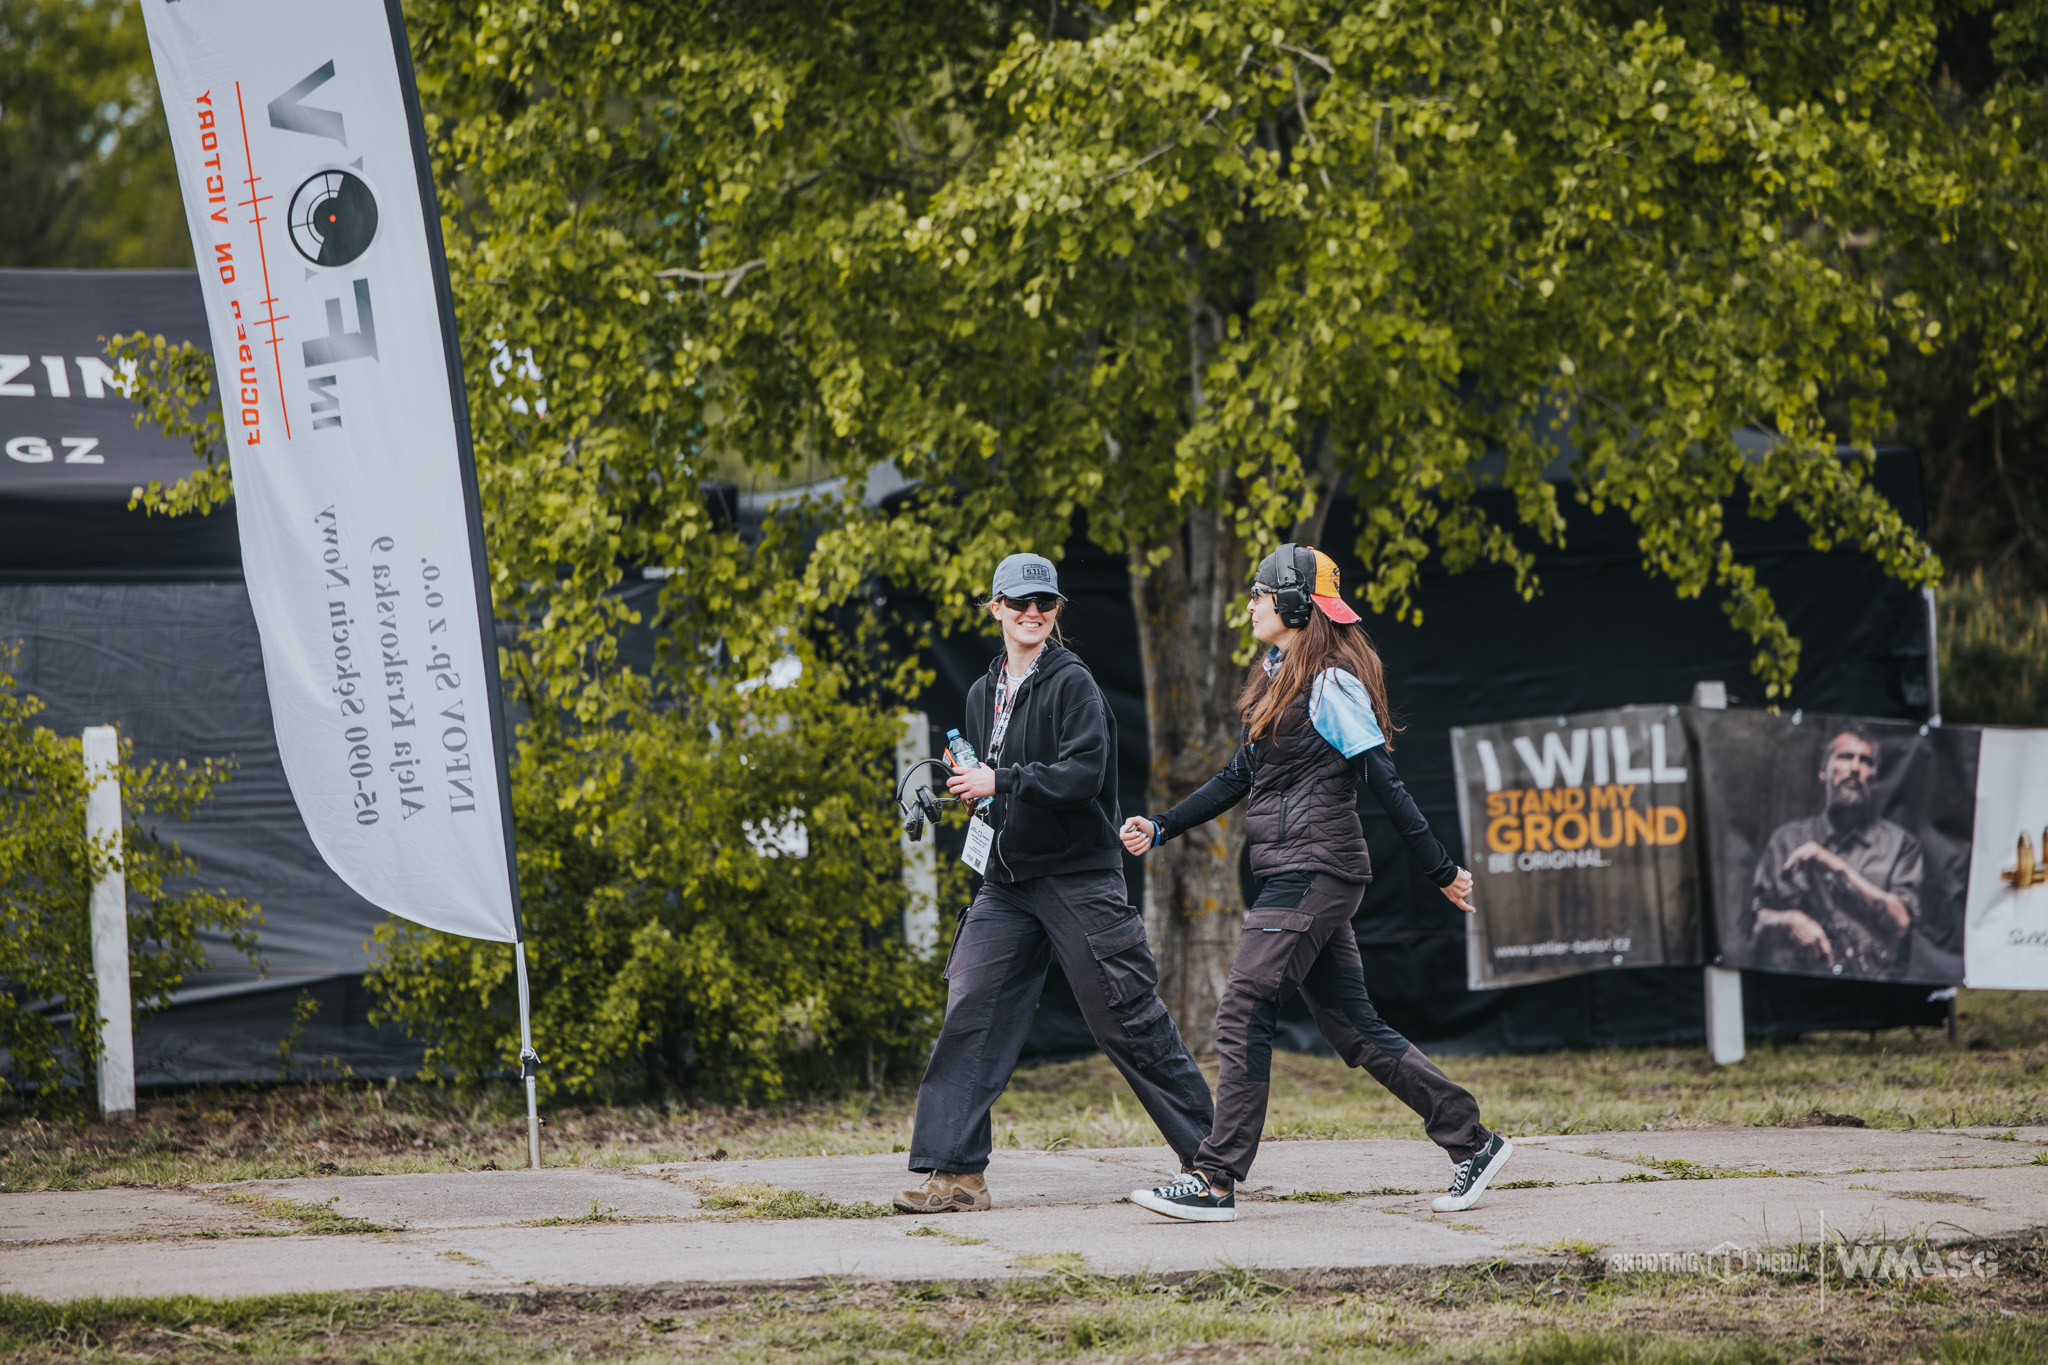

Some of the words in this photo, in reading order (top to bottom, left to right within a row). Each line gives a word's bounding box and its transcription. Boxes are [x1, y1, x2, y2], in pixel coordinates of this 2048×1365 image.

[1476, 739, 1502, 793] I
[1513, 723, 1688, 789] WILL
[1487, 787, 1586, 817] STAND
[1589, 783, 1635, 809] MY
[1487, 805, 1687, 853] GROUND
[1488, 853, 1514, 873] BE
